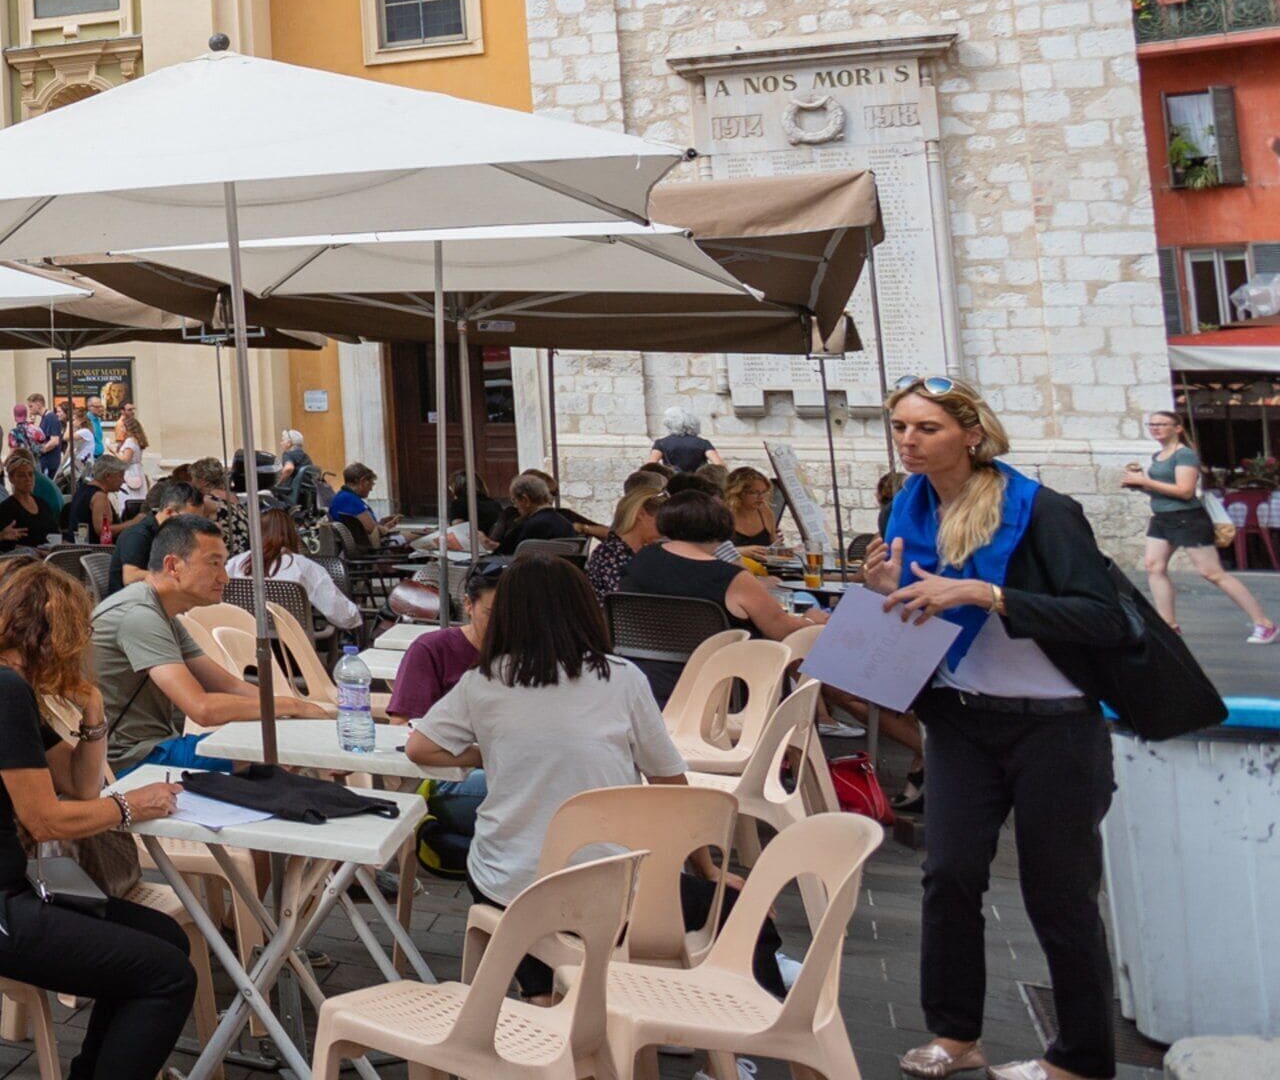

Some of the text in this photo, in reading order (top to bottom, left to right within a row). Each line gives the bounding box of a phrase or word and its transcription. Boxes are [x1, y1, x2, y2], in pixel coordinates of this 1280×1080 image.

[713, 65, 910, 97] A NOS MORTS
[711, 114, 765, 141] 1914
[864, 102, 921, 129] 1918
[72, 368, 128, 377] STABAT MATER
